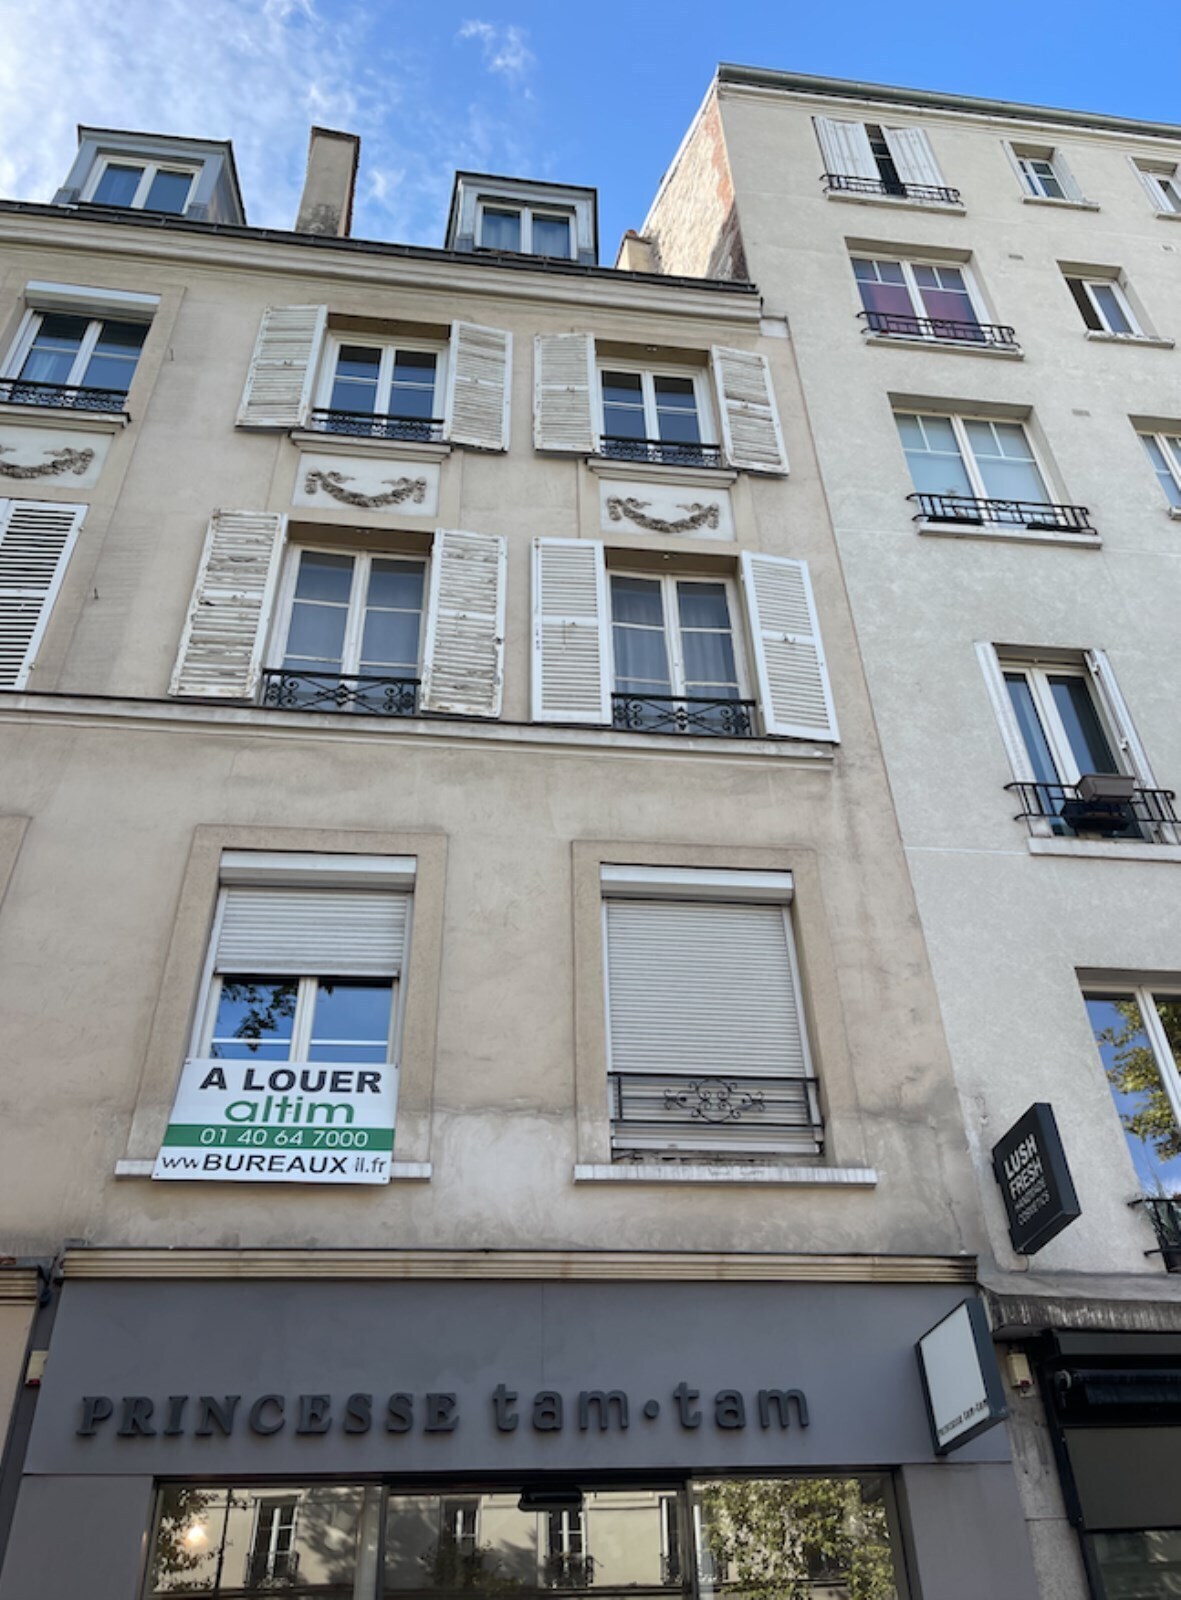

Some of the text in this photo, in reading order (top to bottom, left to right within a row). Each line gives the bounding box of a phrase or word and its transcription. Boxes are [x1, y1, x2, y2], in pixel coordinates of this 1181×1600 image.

[199, 1067, 382, 1093] A LOUER
[224, 1095, 354, 1123] altim
[200, 1127, 369, 1147] 01 40 64 7000
[203, 1153, 348, 1174] BUREAUX
[1003, 1133, 1038, 1180] LUSH
[1009, 1156, 1043, 1200] FRESH
[76, 1391, 460, 1436] PRINCESSE
